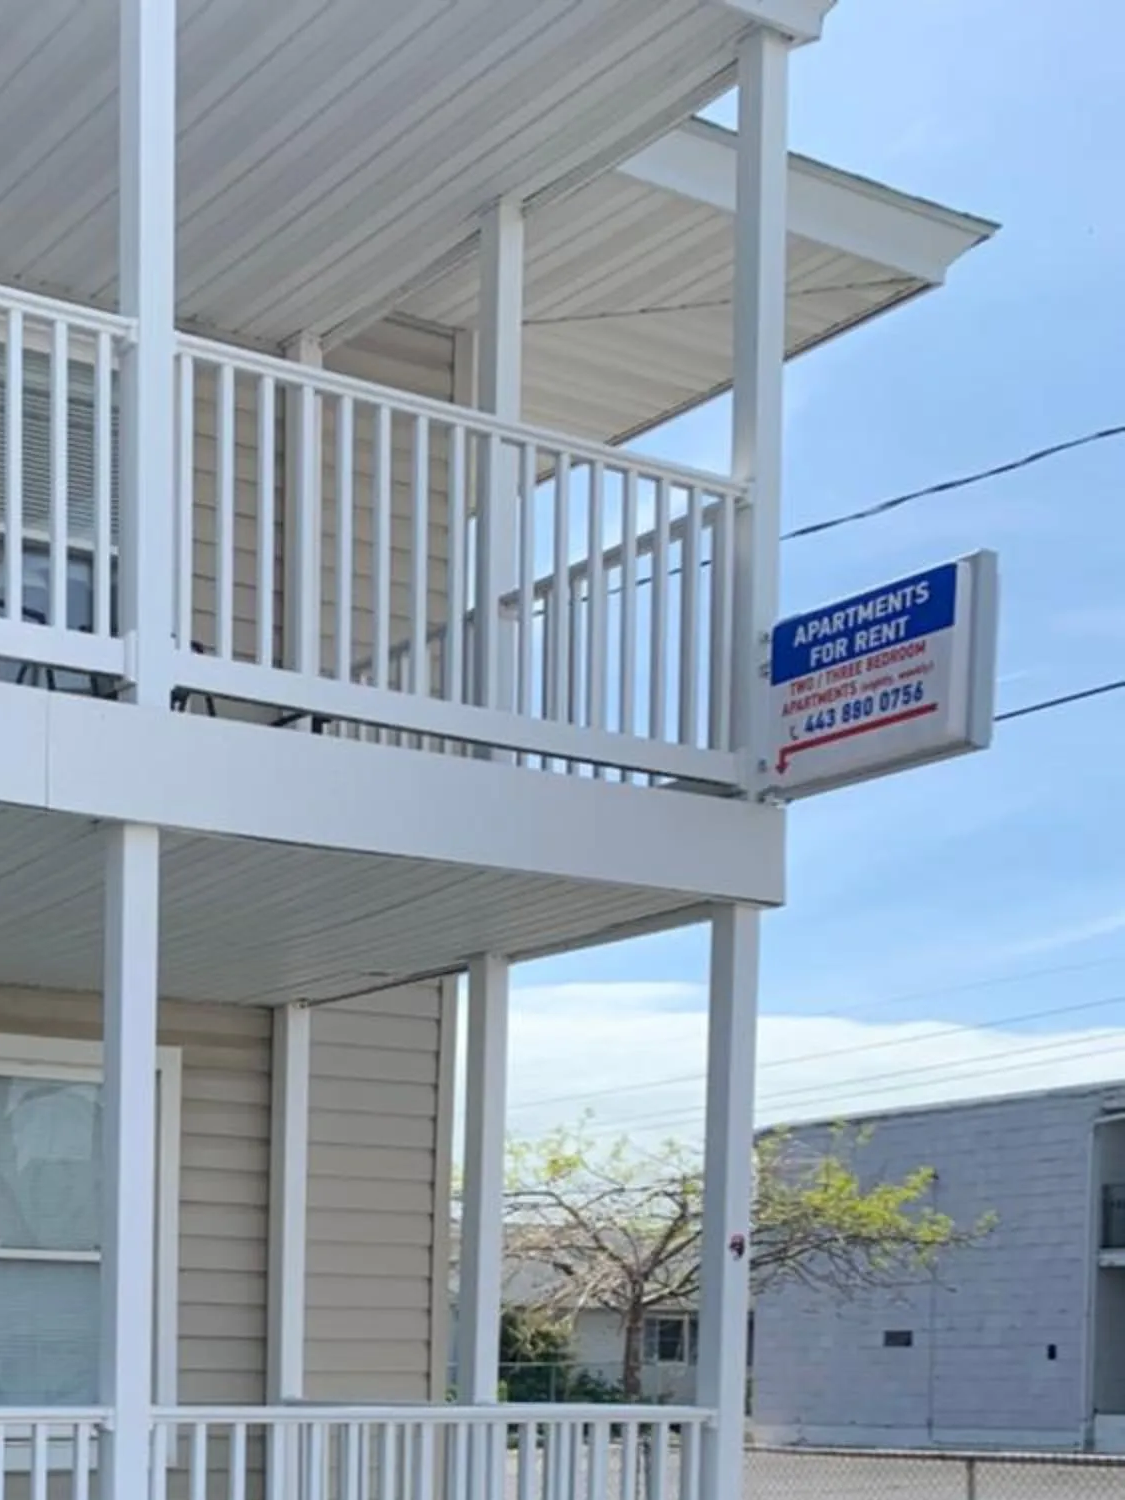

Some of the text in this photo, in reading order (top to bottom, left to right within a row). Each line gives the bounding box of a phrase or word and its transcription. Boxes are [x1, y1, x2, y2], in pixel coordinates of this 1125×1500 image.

[793, 580, 930, 648] APARTMENTS
[810, 615, 910, 667] FOR RENT
[790, 677, 814, 696] TWO
[826, 658, 863, 683] THREE
[865, 640, 926, 671] BEDROOM
[782, 682, 858, 716] APARTMENTS
[805, 707, 836, 733] 443
[879, 681, 924, 713] 0756
